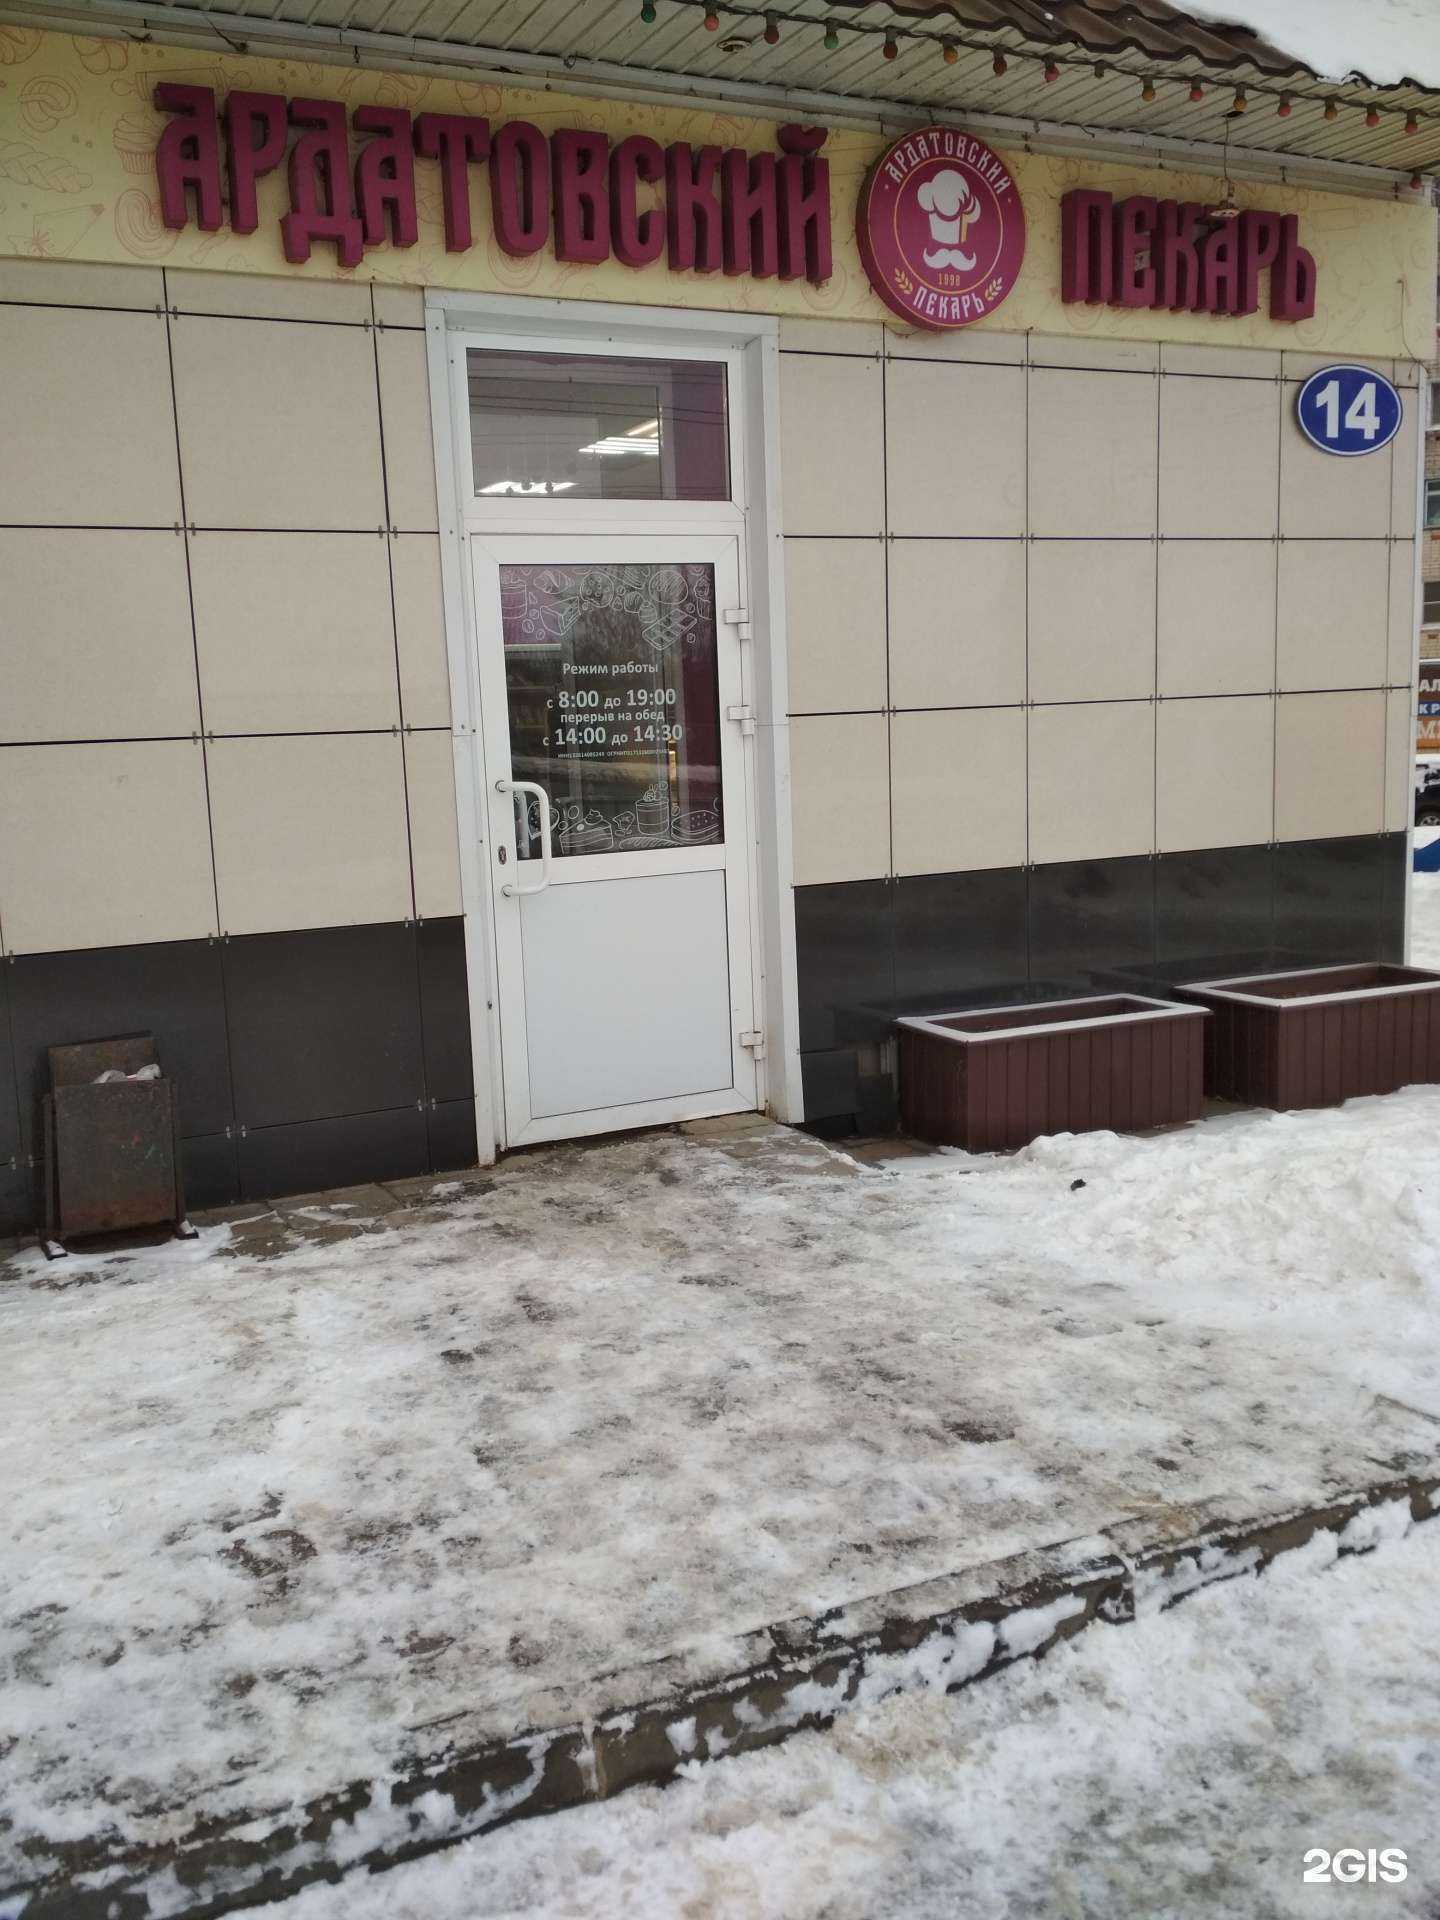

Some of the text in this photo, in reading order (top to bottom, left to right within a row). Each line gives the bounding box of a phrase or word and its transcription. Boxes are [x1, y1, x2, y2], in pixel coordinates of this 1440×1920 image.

[154, 81, 833, 283] АРДАТОВСКИЙ
[1061, 188, 1317, 323] ПЕКАРЬ
[938, 272, 961, 287] 1998
[912, 285, 985, 320] ПЕКАРЬ
[1315, 379, 1381, 440] 14
[562, 661, 658, 676] Режим работы
[558, 690, 600, 709] 8:00
[604, 697, 622, 710] до
[626, 688, 677, 707] 19:00
[560, 709, 665, 725] перерыв на обед
[555, 726, 607, 746] 14:00
[611, 734, 629, 746] до
[633, 723, 683, 743] 14:30
